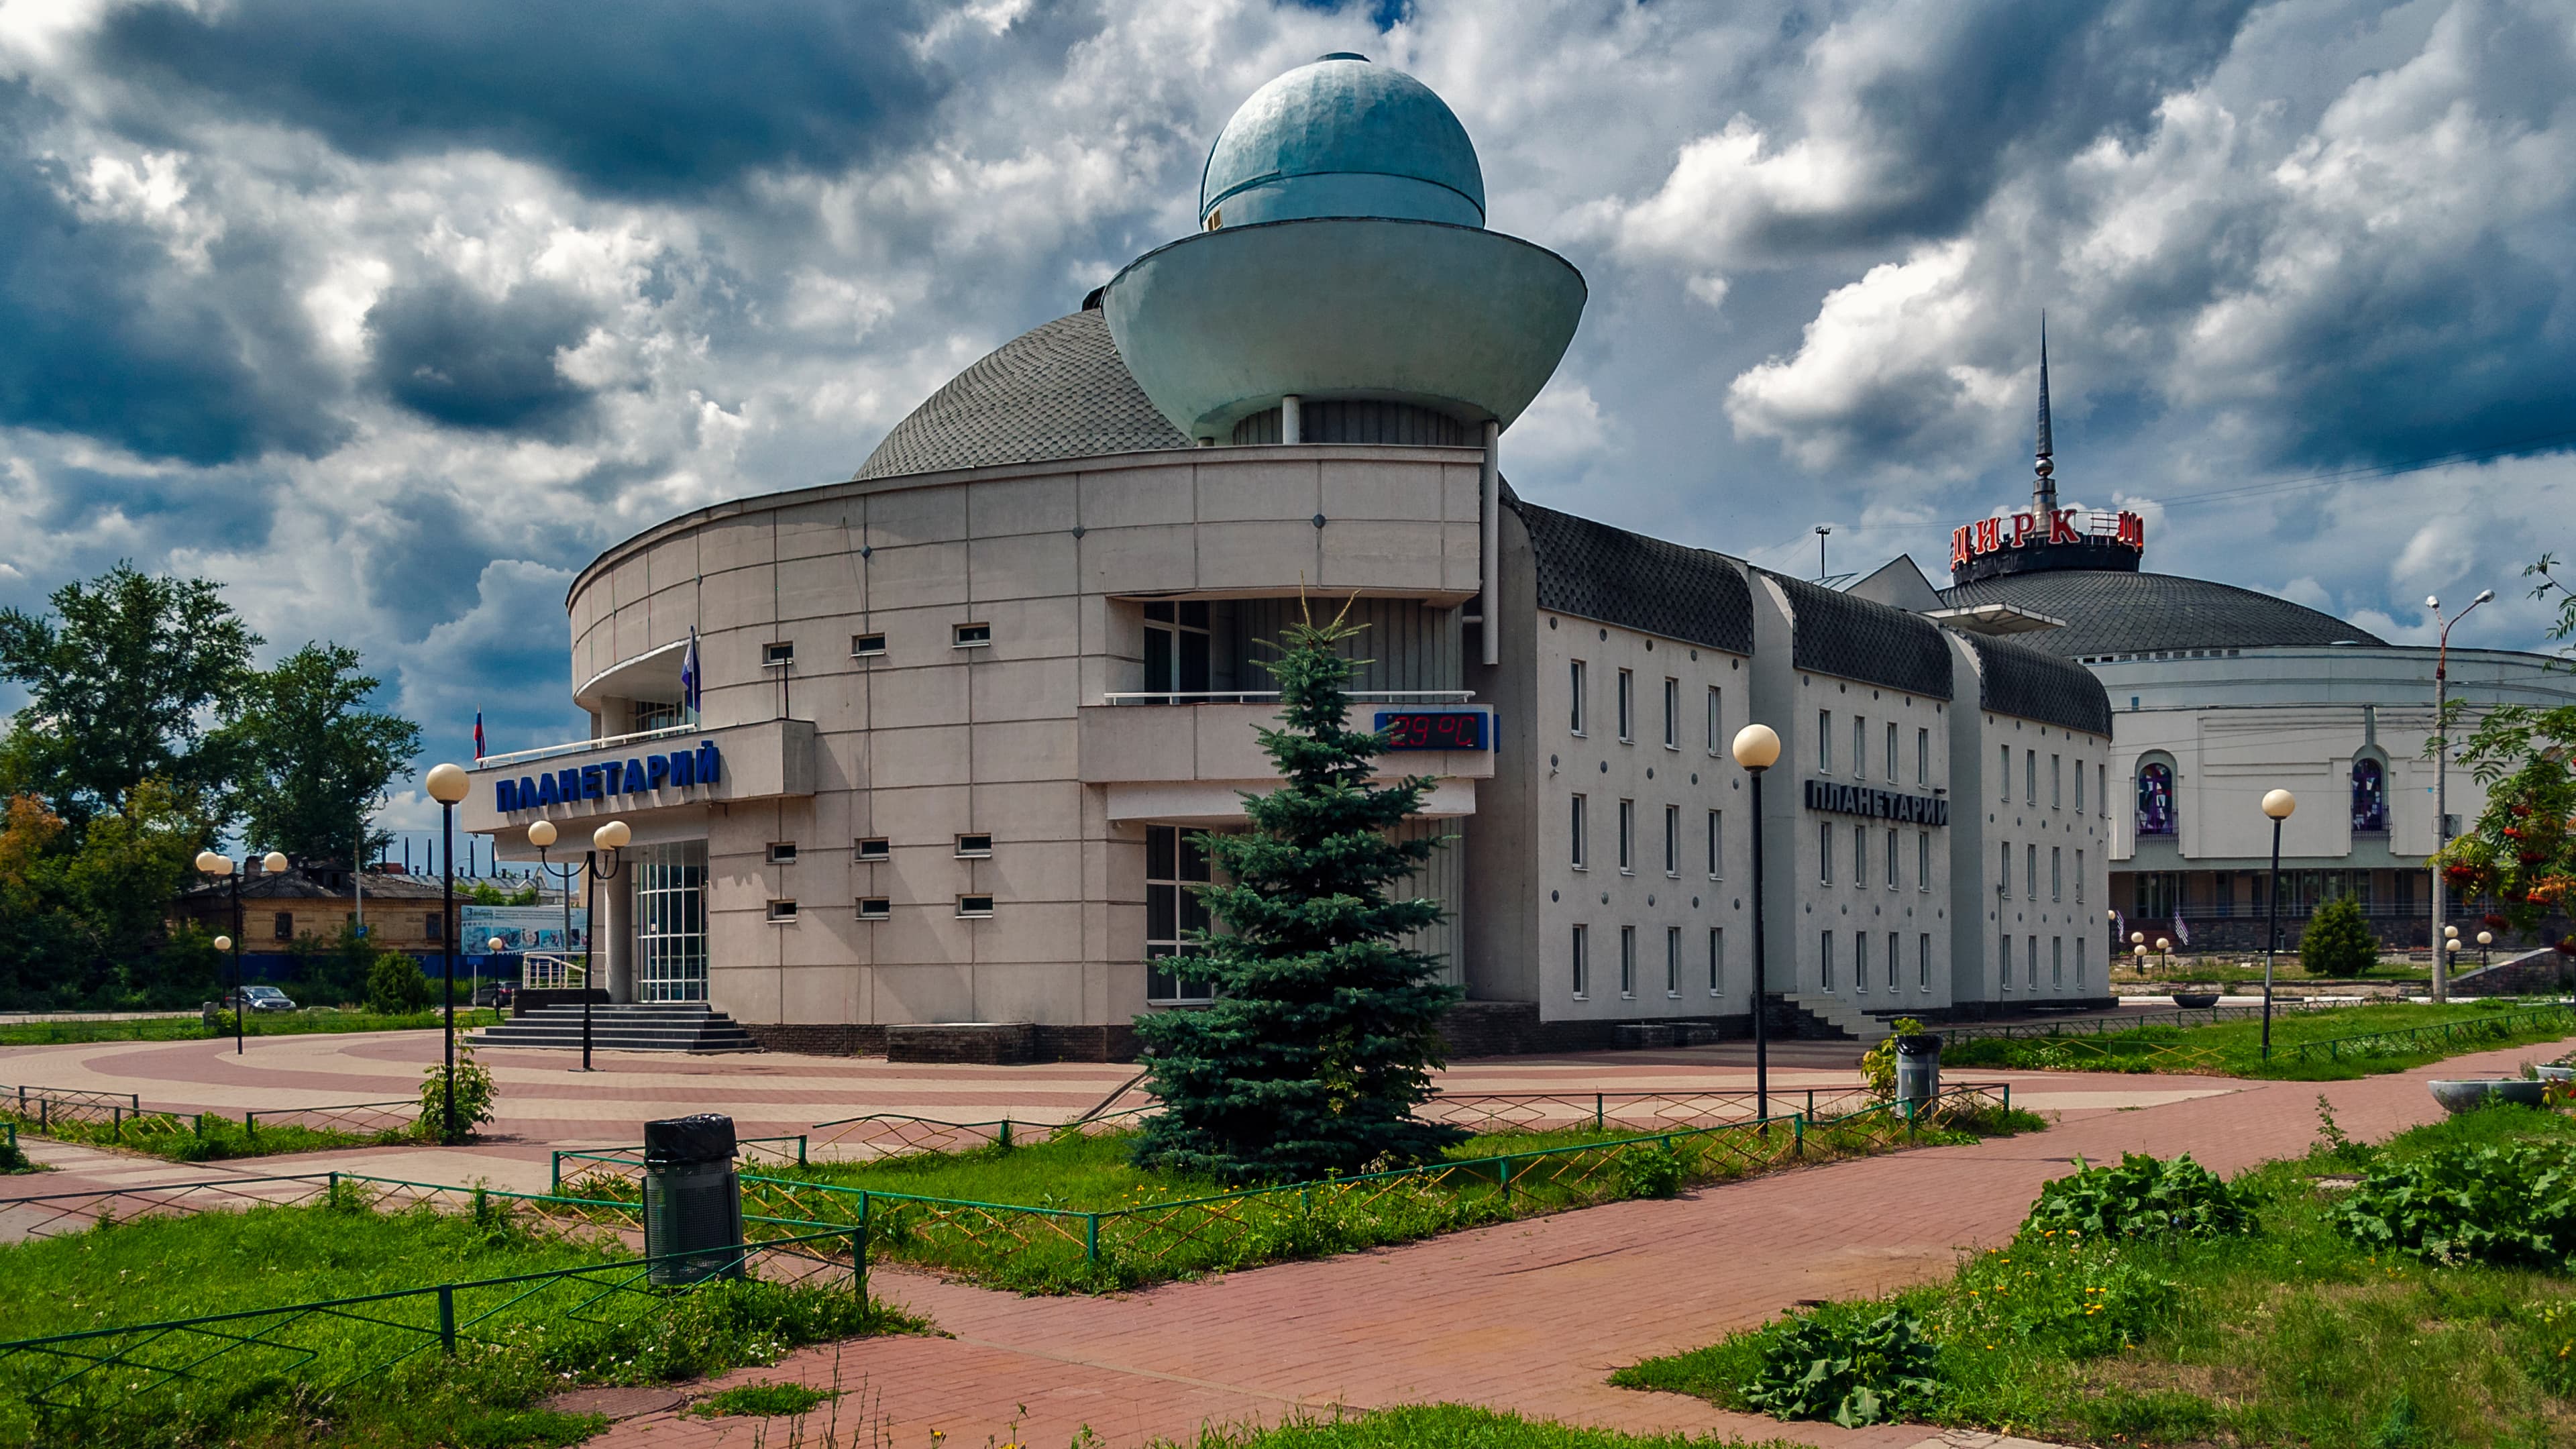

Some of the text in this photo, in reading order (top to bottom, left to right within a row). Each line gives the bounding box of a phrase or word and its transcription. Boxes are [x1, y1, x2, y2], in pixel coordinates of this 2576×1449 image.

[1952, 509, 2081, 564] ЦИРК
[1389, 716, 1430, 747] 29
[496, 740, 720, 812] ПЛАНЕТАРИЙ
